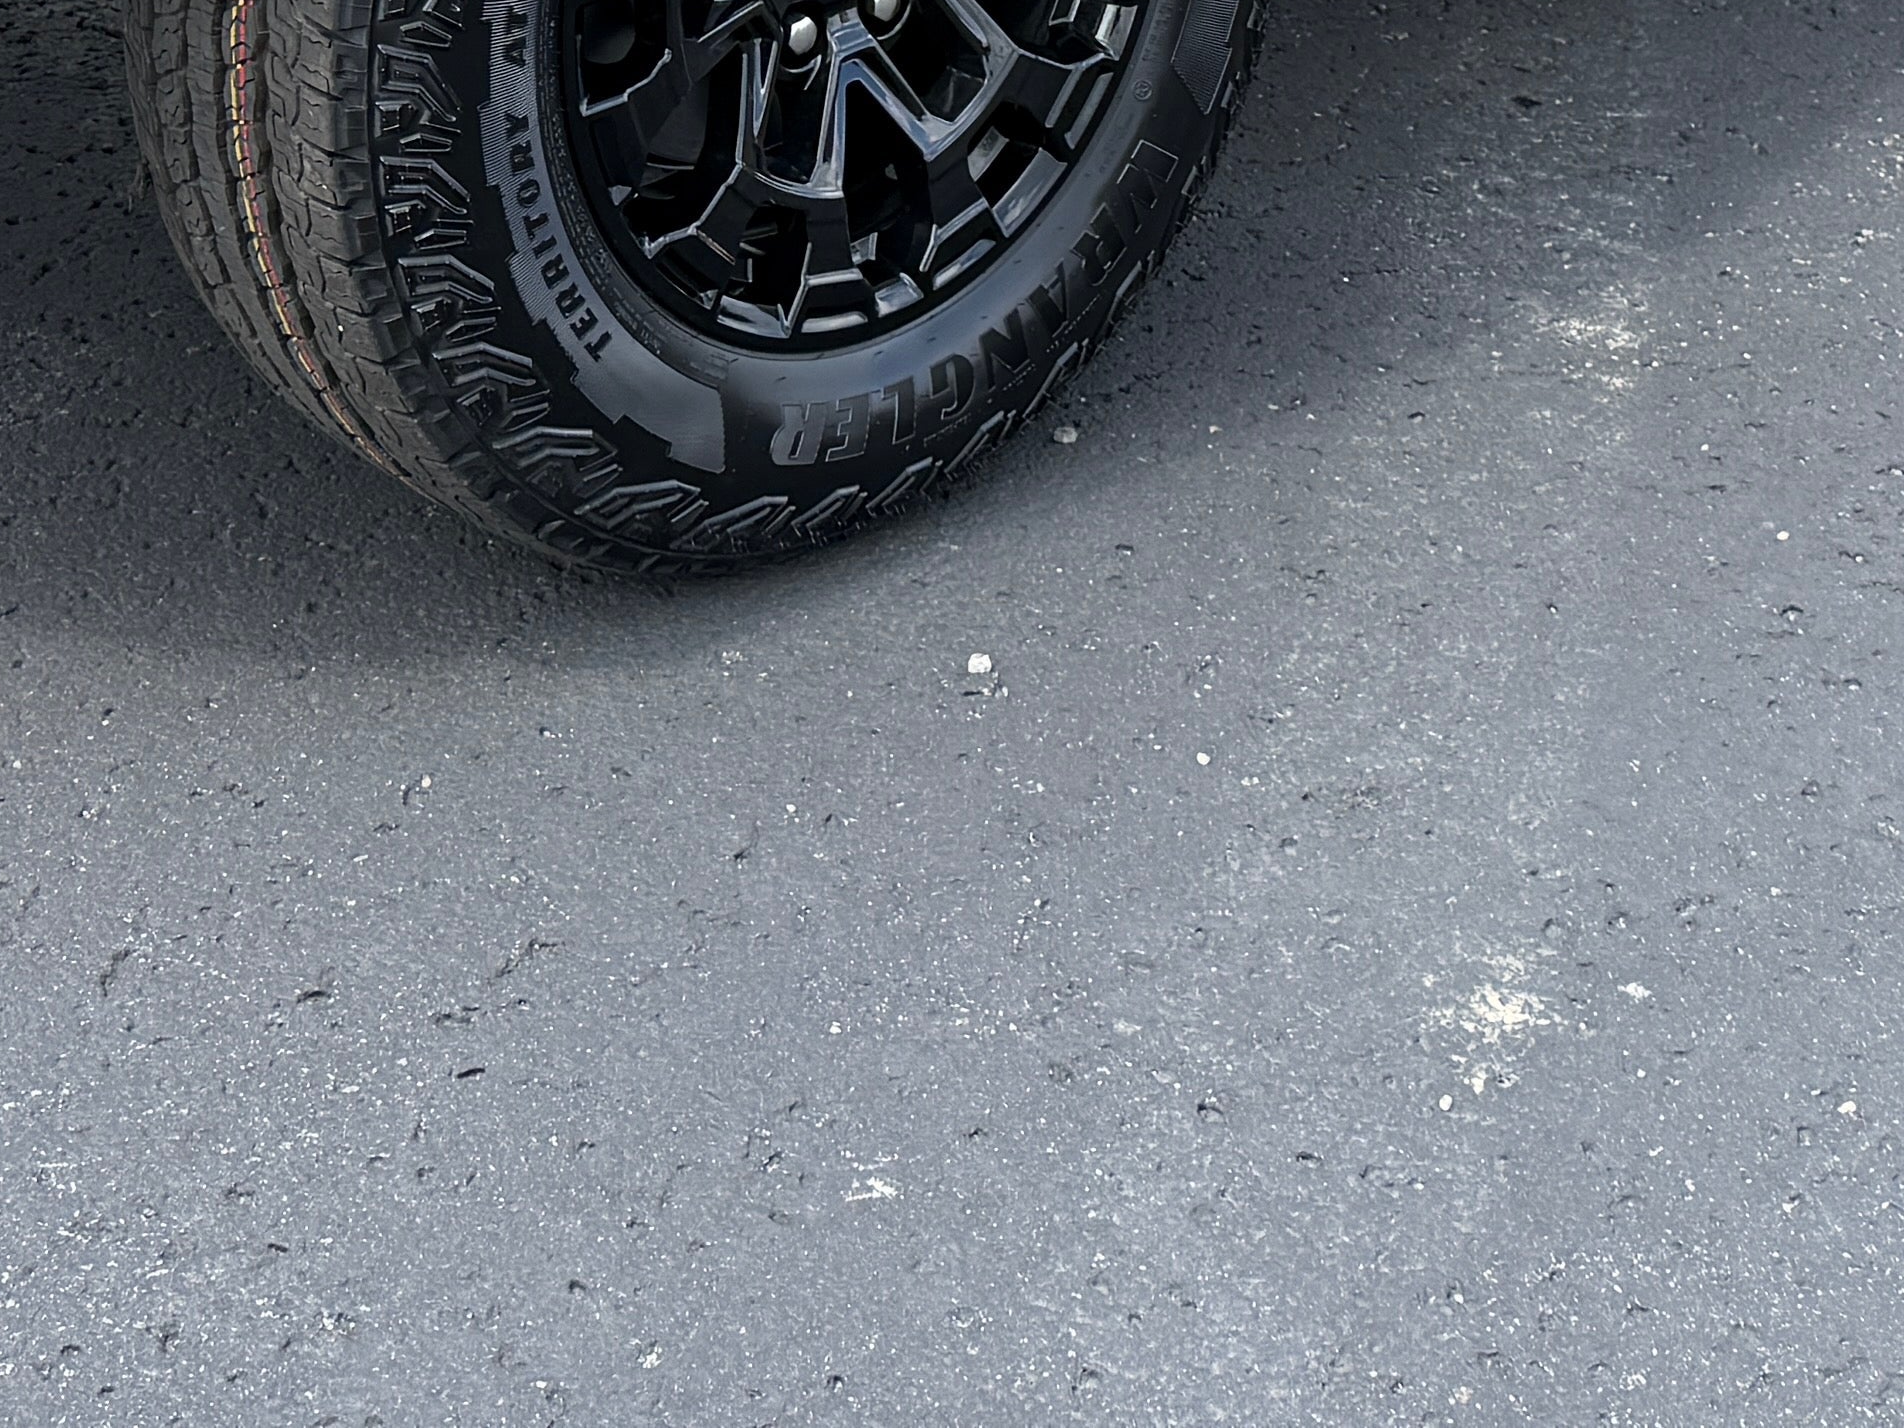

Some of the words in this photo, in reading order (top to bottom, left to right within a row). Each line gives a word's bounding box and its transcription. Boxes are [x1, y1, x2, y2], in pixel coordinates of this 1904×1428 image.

[504, 6, 530, 67] AT
[503, 112, 614, 363] TERRITORY
[768, 138, 1180, 468] WRANGLER
